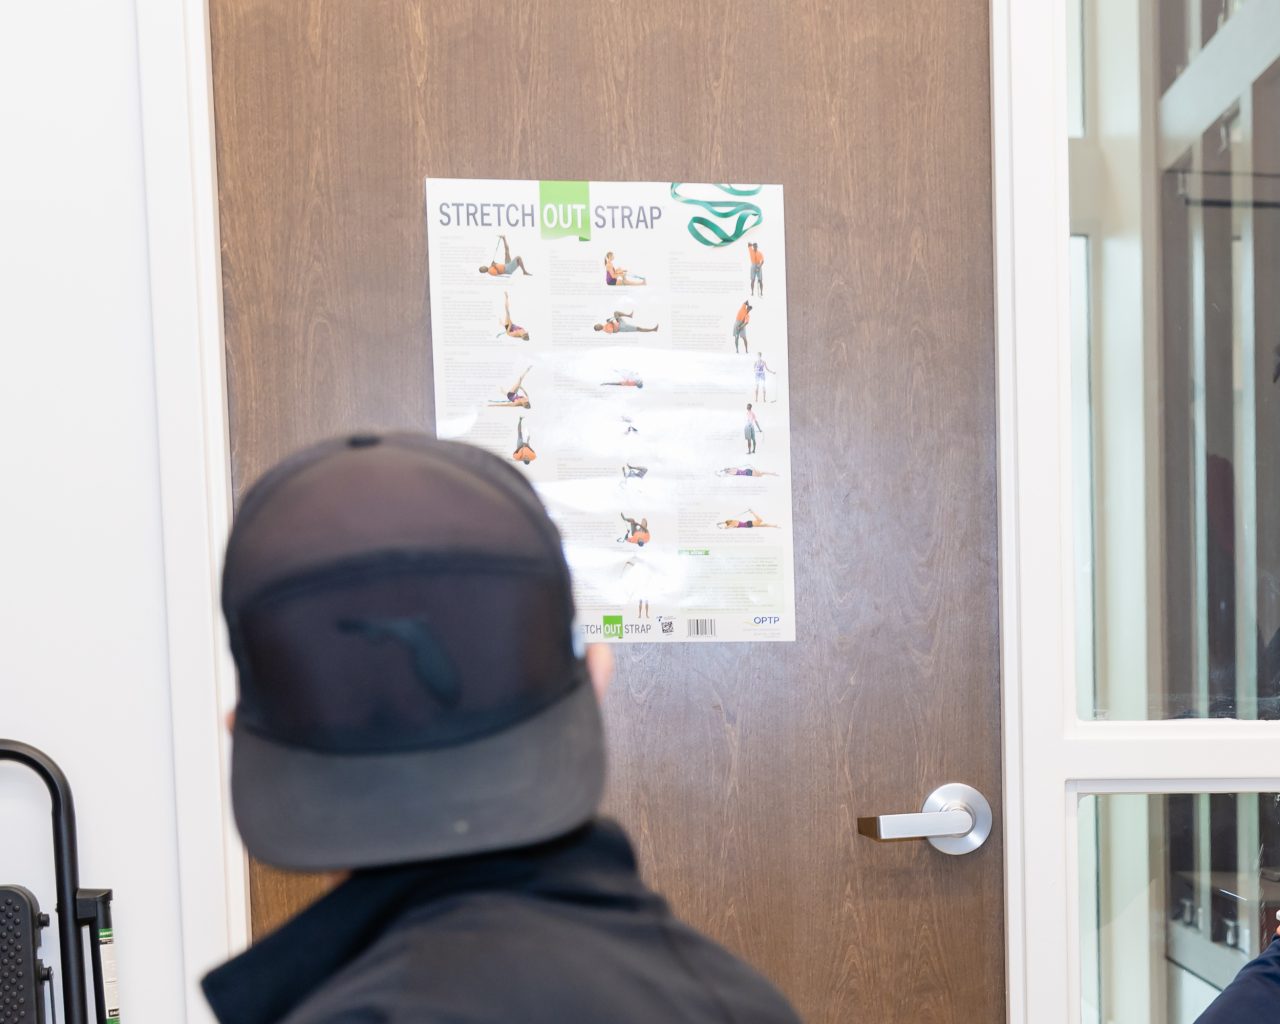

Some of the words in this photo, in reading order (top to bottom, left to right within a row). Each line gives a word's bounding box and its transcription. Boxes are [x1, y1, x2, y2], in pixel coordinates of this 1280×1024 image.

[439, 202, 535, 228] STRETCH
[543, 204, 586, 229] OUT
[594, 205, 662, 230] STRAP
[753, 616, 780, 625] OPTP
[604, 623, 622, 635] OUT
[624, 624, 652, 635] STRAP
